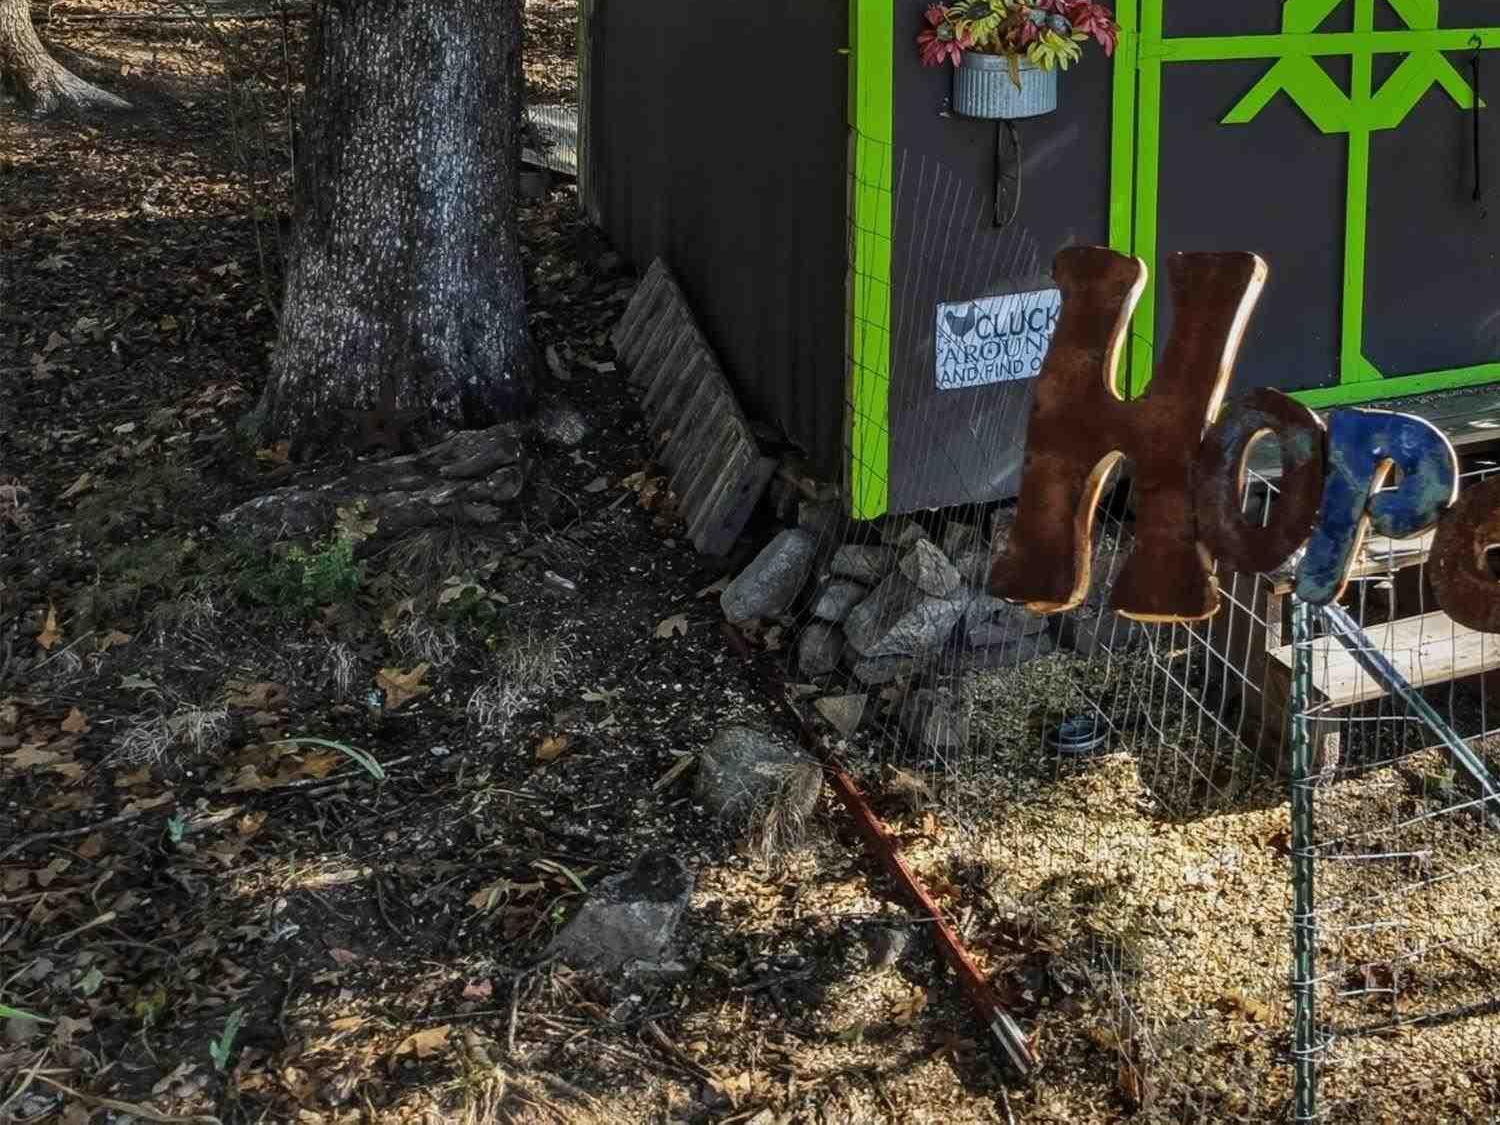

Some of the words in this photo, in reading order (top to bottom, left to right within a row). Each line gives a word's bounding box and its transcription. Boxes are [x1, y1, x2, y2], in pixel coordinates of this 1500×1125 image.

[942, 333, 1048, 365] AROUN
[941, 365, 980, 385] AND
[985, 359, 1024, 377] FIND
